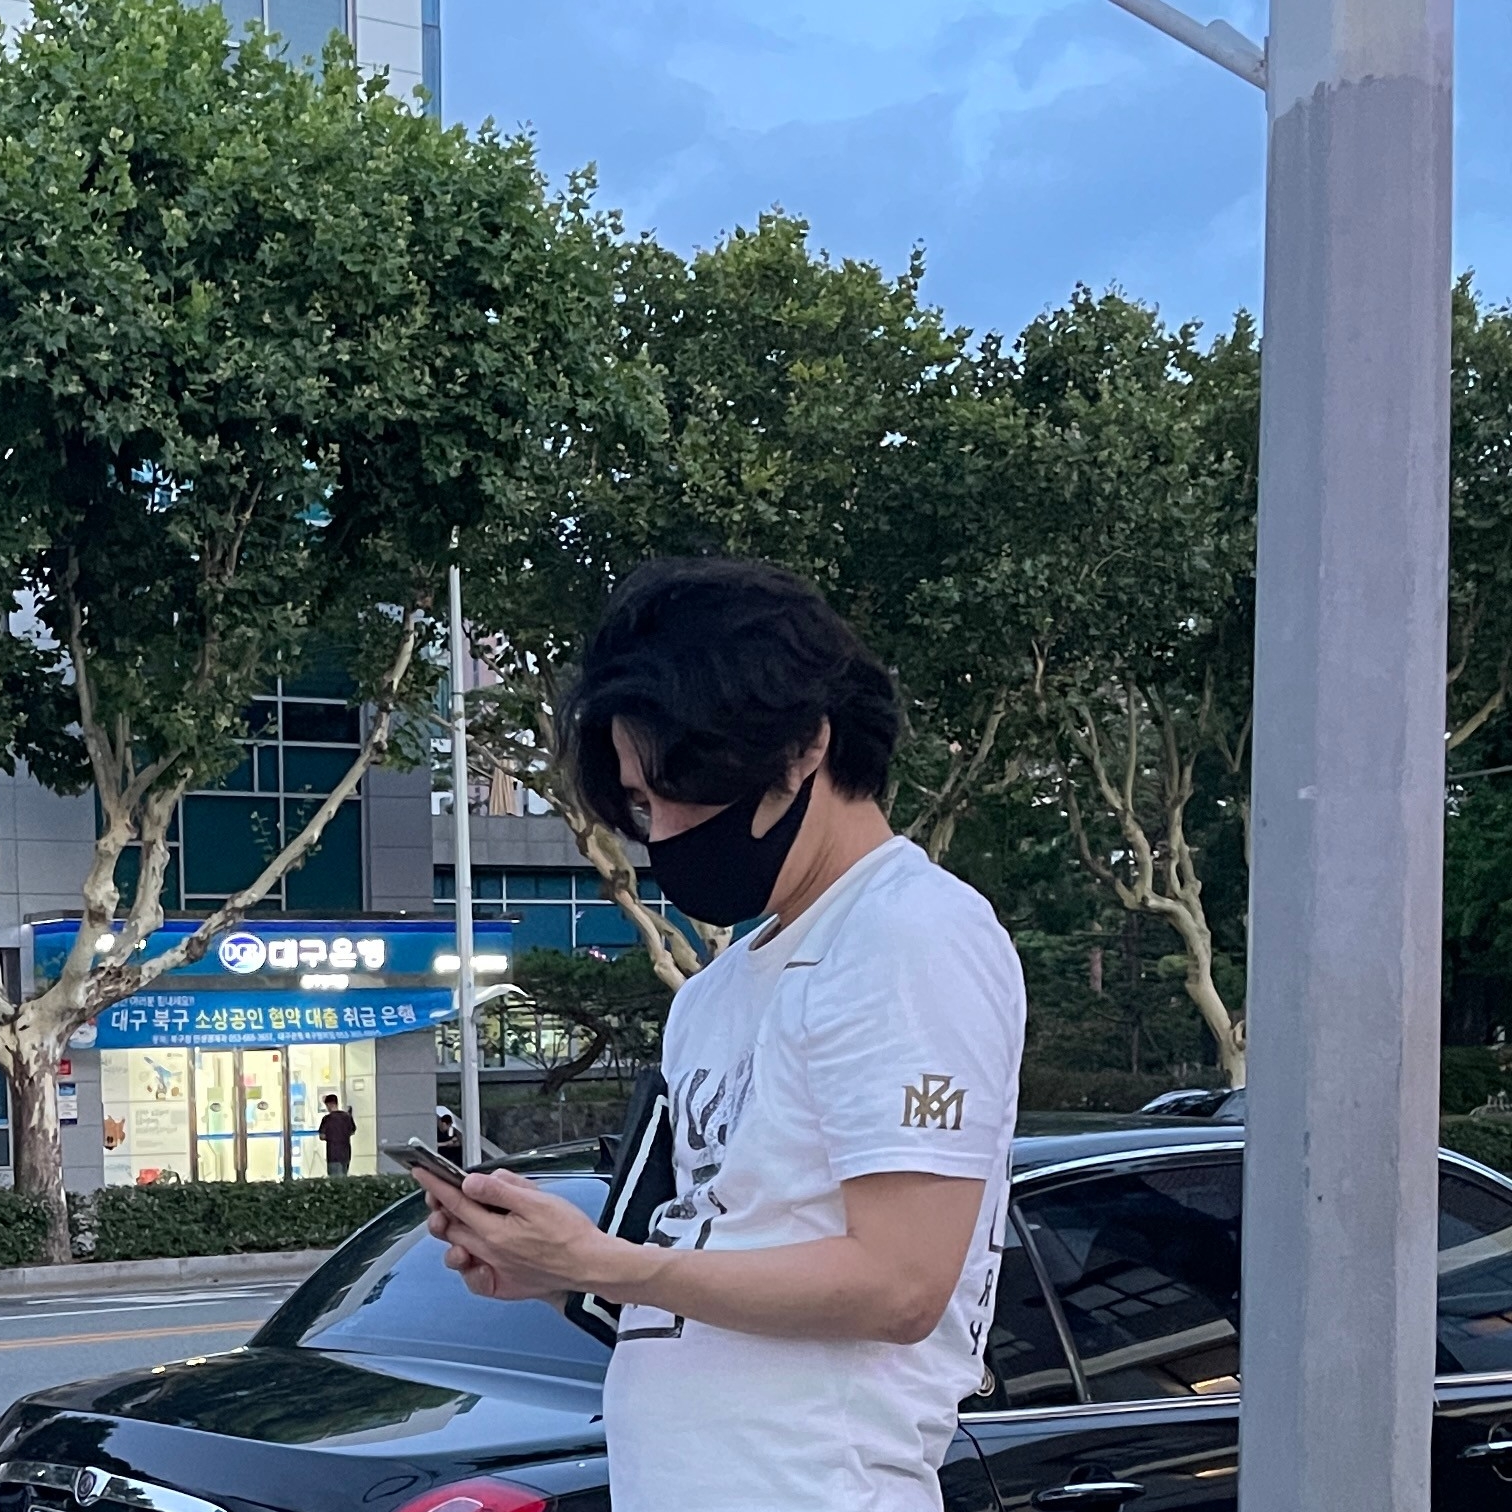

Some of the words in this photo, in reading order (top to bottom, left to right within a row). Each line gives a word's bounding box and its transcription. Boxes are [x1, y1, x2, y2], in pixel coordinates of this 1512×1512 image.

[268, 937, 385, 968] 대구은행
[111, 1009, 148, 1032] 대구
[152, 1009, 190, 1032] 북구
[195, 1007, 264, 1031] 소상공인
[268, 1006, 301, 1030] 협약
[305, 1007, 339, 1029] 대출
[343, 1006, 376, 1028] 취급
[381, 1004, 416, 1026] 은행
